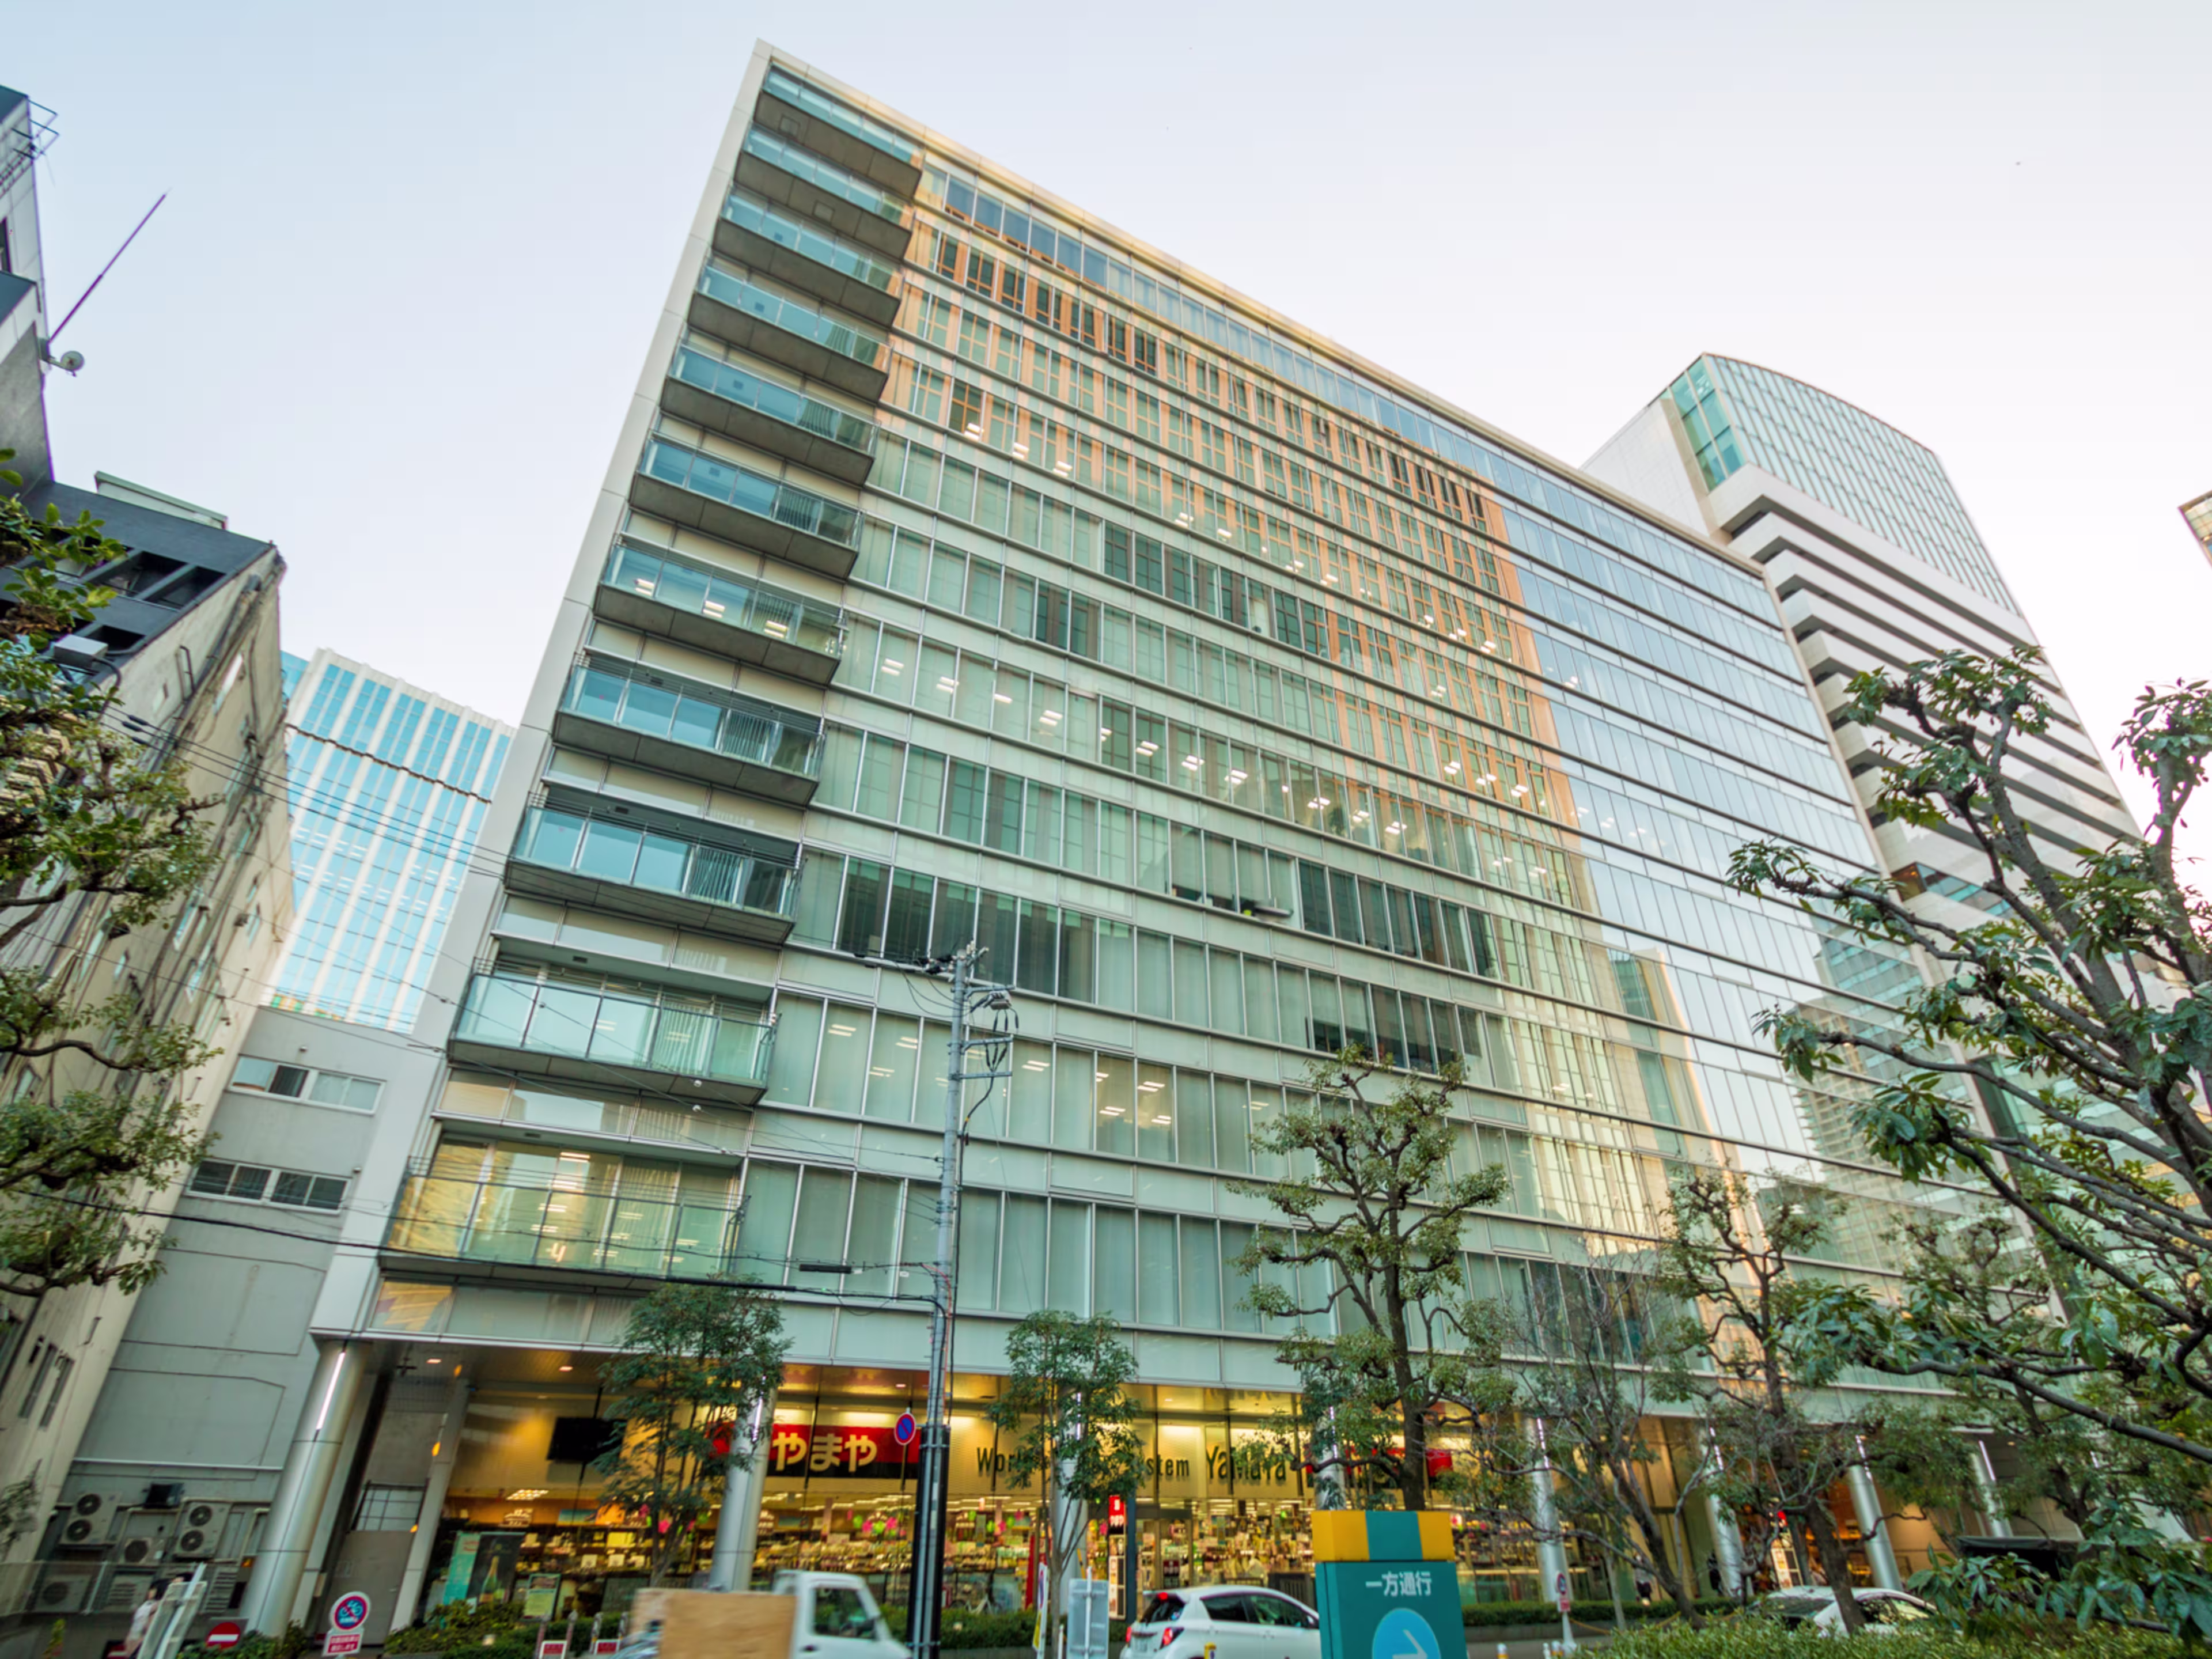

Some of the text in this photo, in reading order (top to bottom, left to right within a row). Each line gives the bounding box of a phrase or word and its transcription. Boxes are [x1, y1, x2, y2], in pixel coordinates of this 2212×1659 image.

[772, 1432, 877, 1472] やまや
[1365, 1571, 1432, 1597] 一方通行
